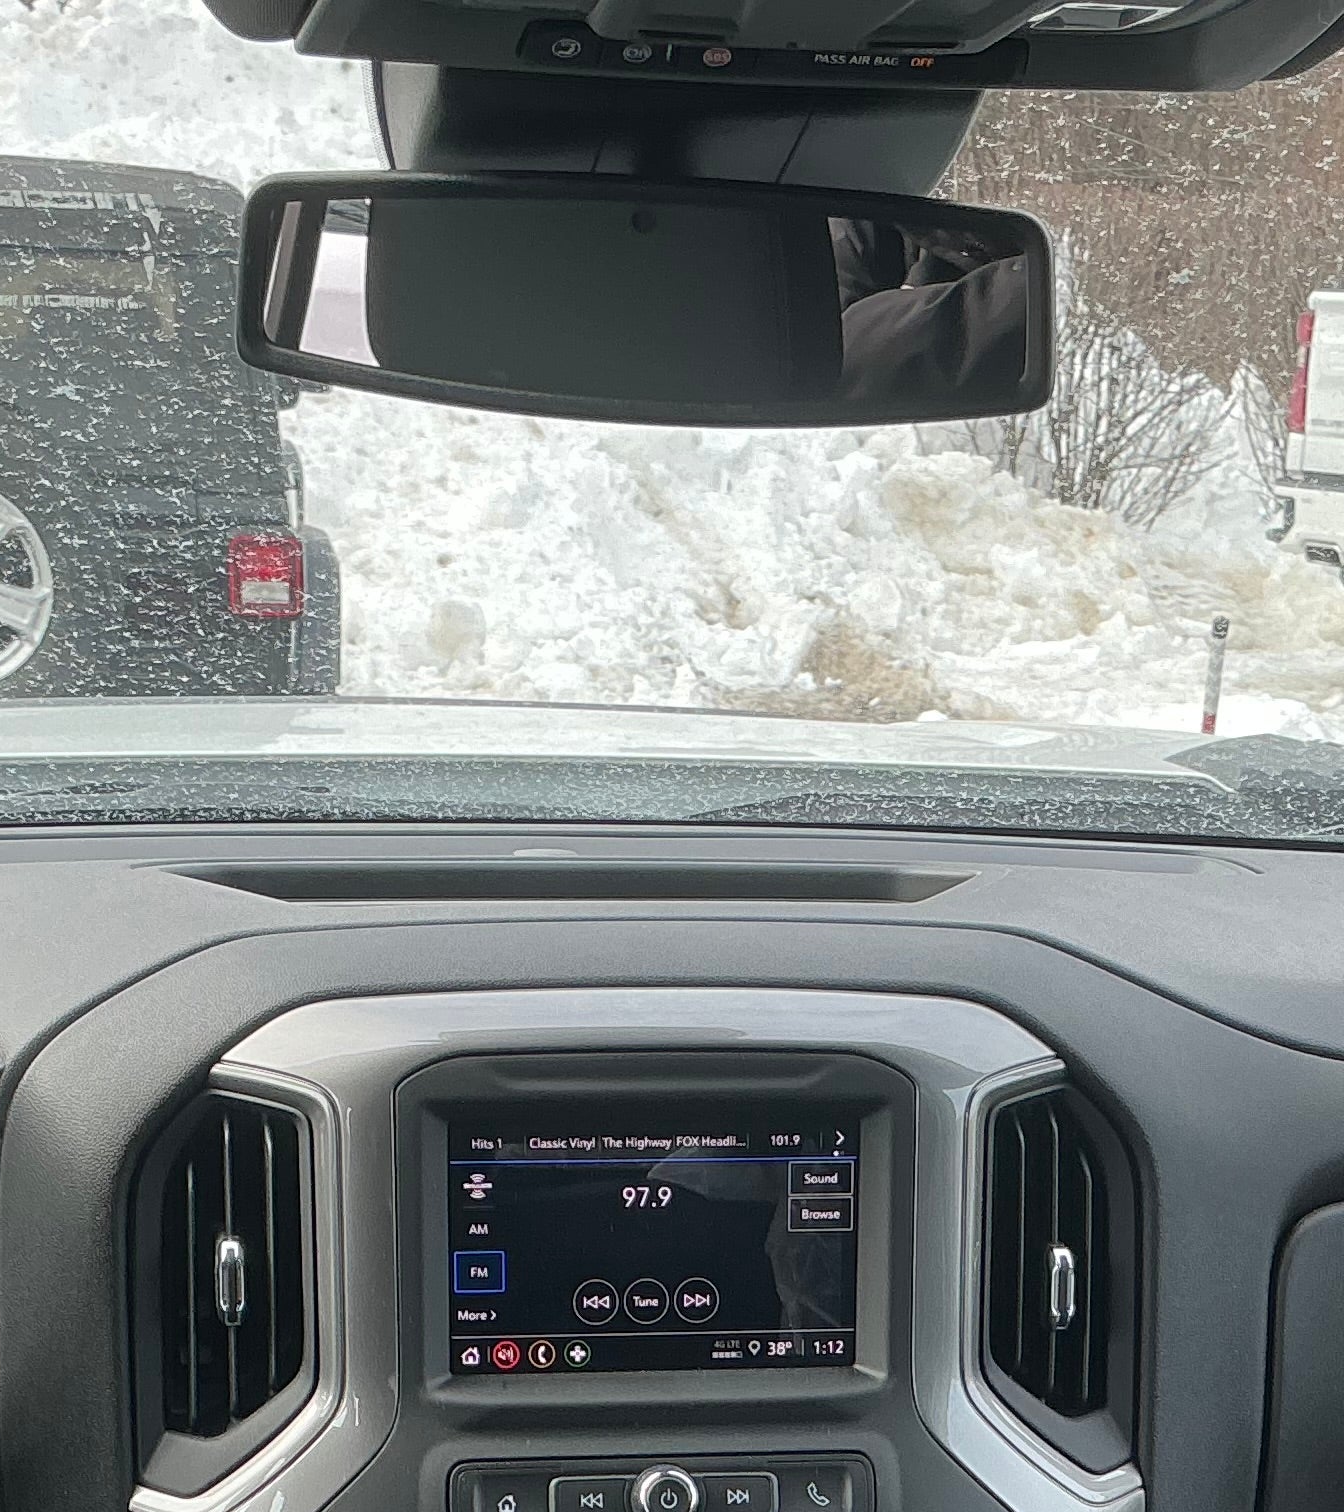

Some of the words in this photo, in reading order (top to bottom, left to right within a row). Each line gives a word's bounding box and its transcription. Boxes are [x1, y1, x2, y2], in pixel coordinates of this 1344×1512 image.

[814, 54, 846, 64] PASS
[848, 56, 871, 65] AIR
[874, 56, 900, 66] BAG
[910, 57, 936, 67] OFF
[471, 1138, 494, 1150] Hits
[529, 1137, 567, 1150] Classic
[569, 1137, 596, 1152] Vinyl
[602, 1136, 623, 1148] The
[625, 1136, 672, 1151] Highway
[676, 1135, 700, 1147] FOX
[770, 1134, 801, 1146] 101.9
[804, 1172, 838, 1184] Sound
[622, 1186, 672, 1208] 97.9
[801, 1208, 841, 1220] Browse
[468, 1223, 489, 1234] AM
[470, 1266, 489, 1278] FM
[632, 1296, 659, 1307] Tune
[458, 1310, 488, 1321] More
[813, 1340, 844, 1354] 1:12
